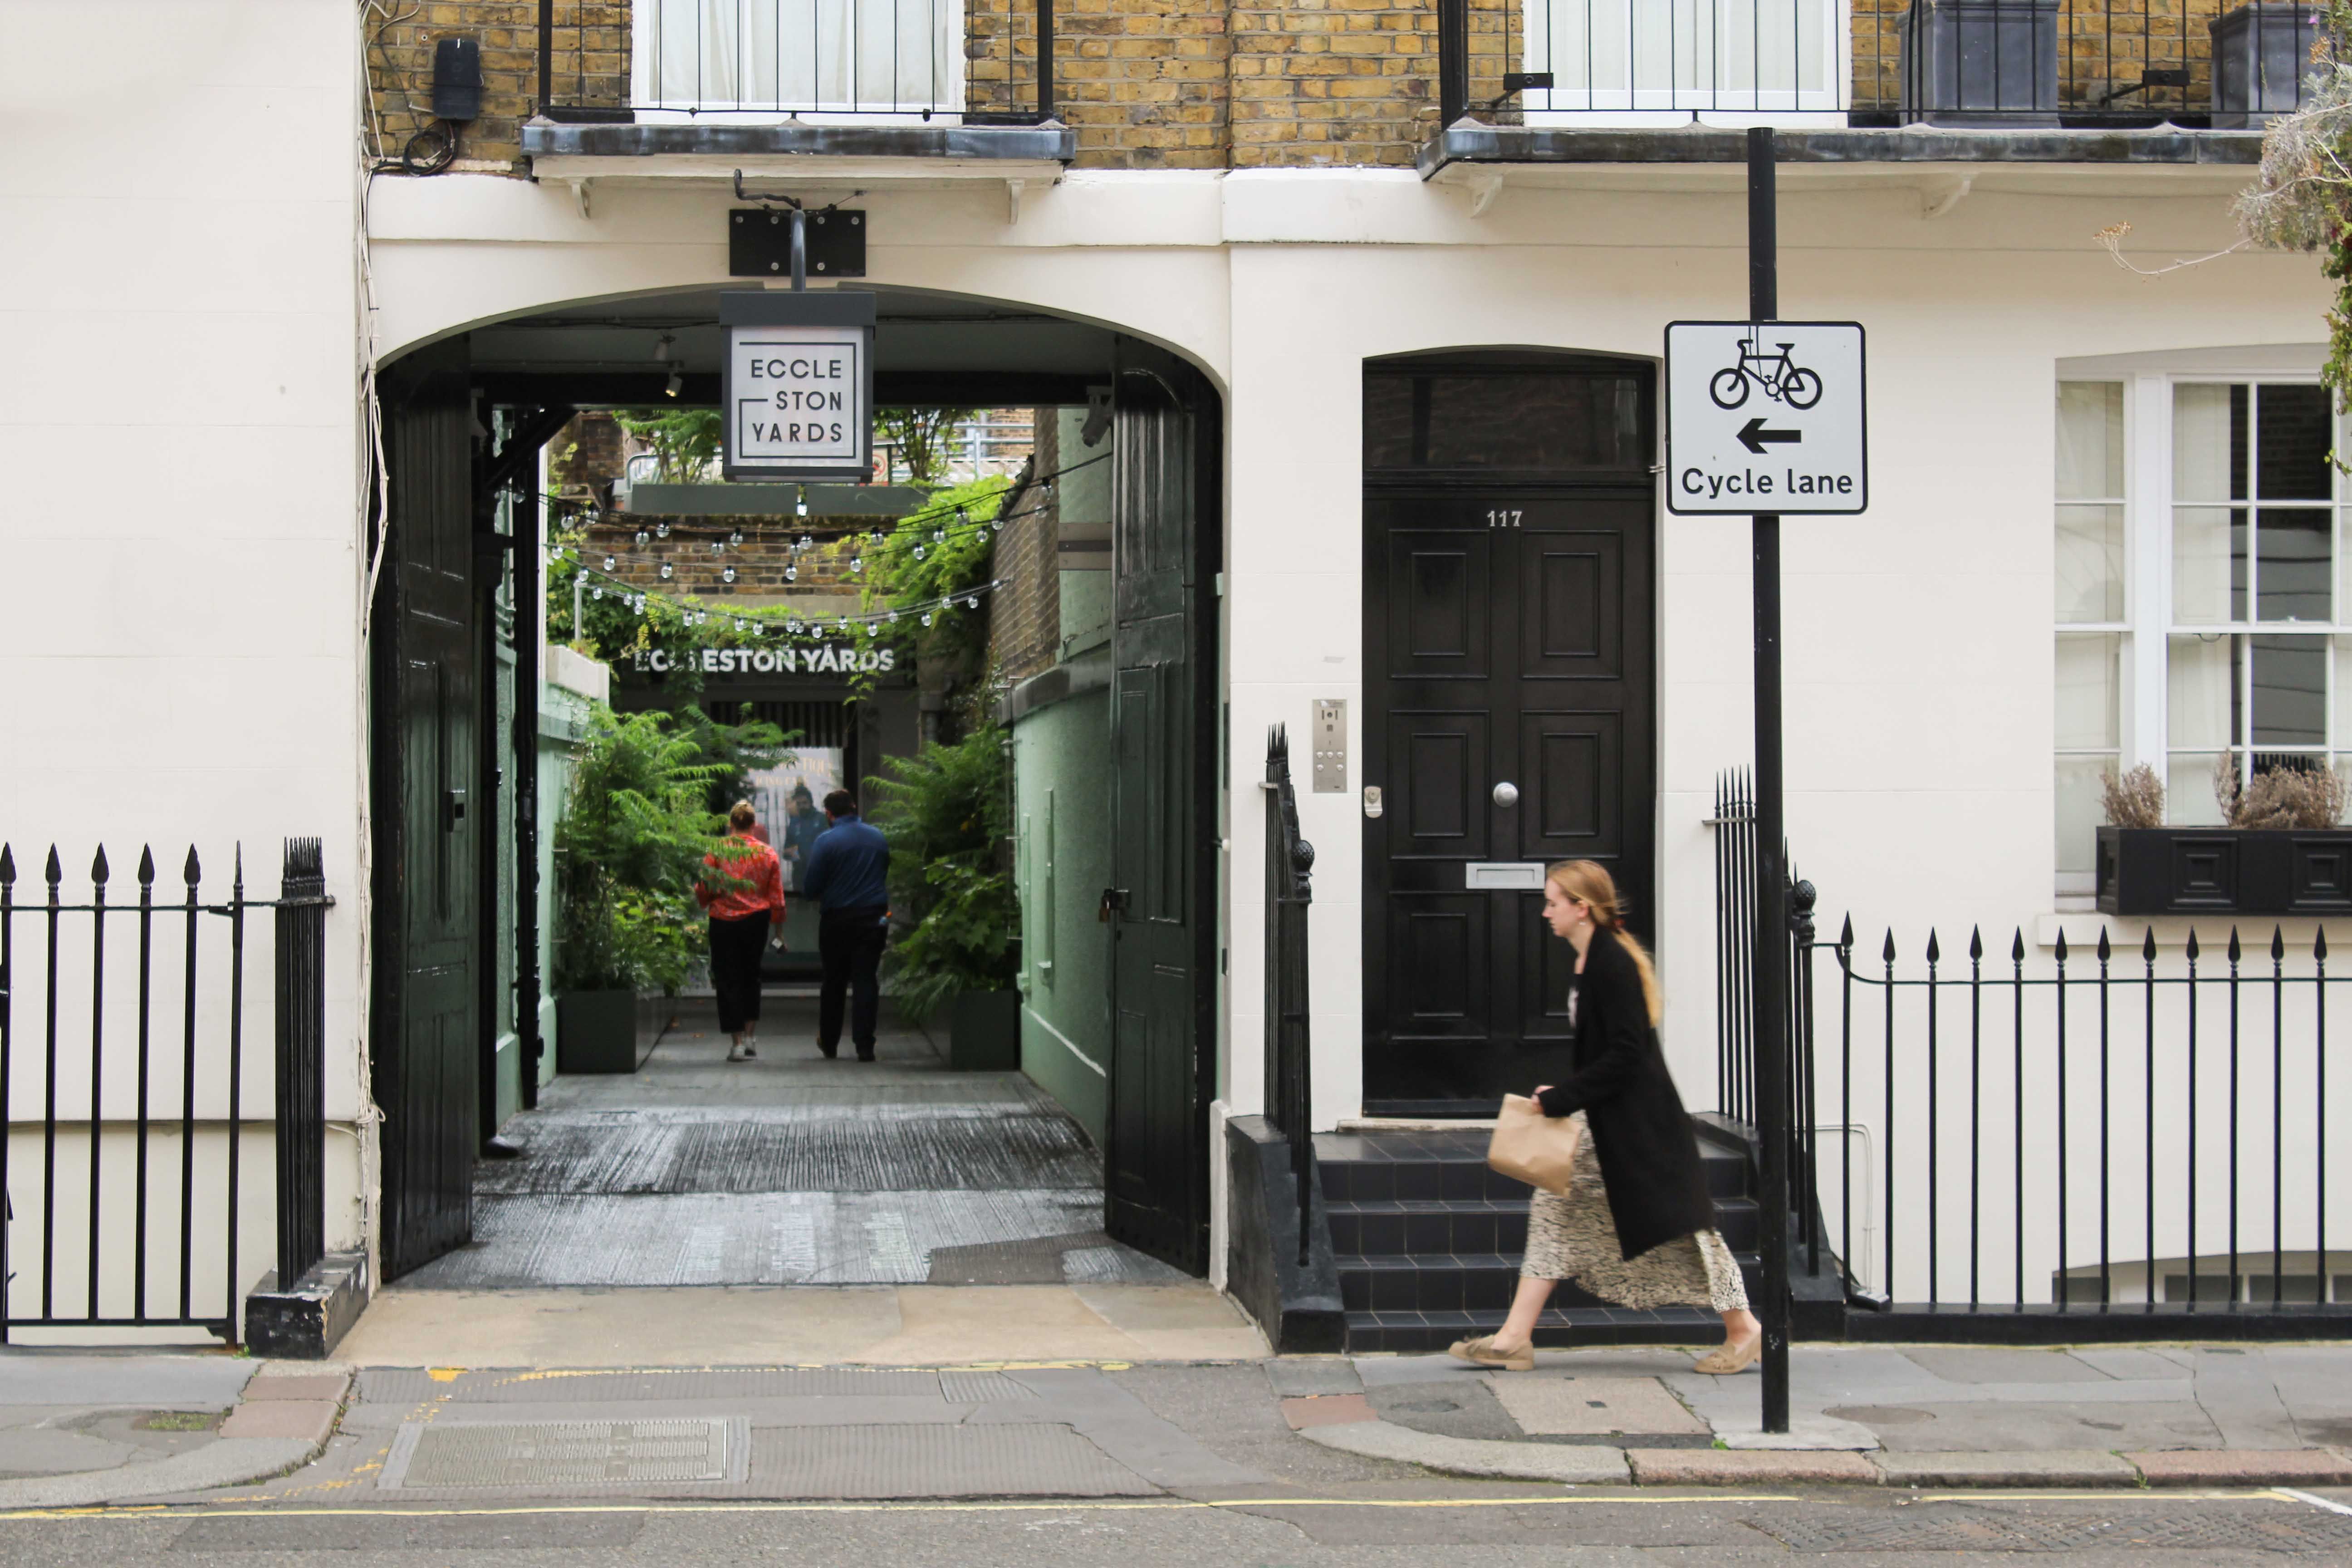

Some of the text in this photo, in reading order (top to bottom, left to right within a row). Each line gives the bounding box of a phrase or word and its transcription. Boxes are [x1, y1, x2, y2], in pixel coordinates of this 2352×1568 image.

[751, 360, 841, 379] ECCLE
[776, 391, 842, 411] STON
[752, 423, 842, 442] YARDS
[1682, 468, 1852, 499] Cycle lane
[1487, 510, 1522, 527] 117
[634, 649, 895, 672] ECESTON YARDS
